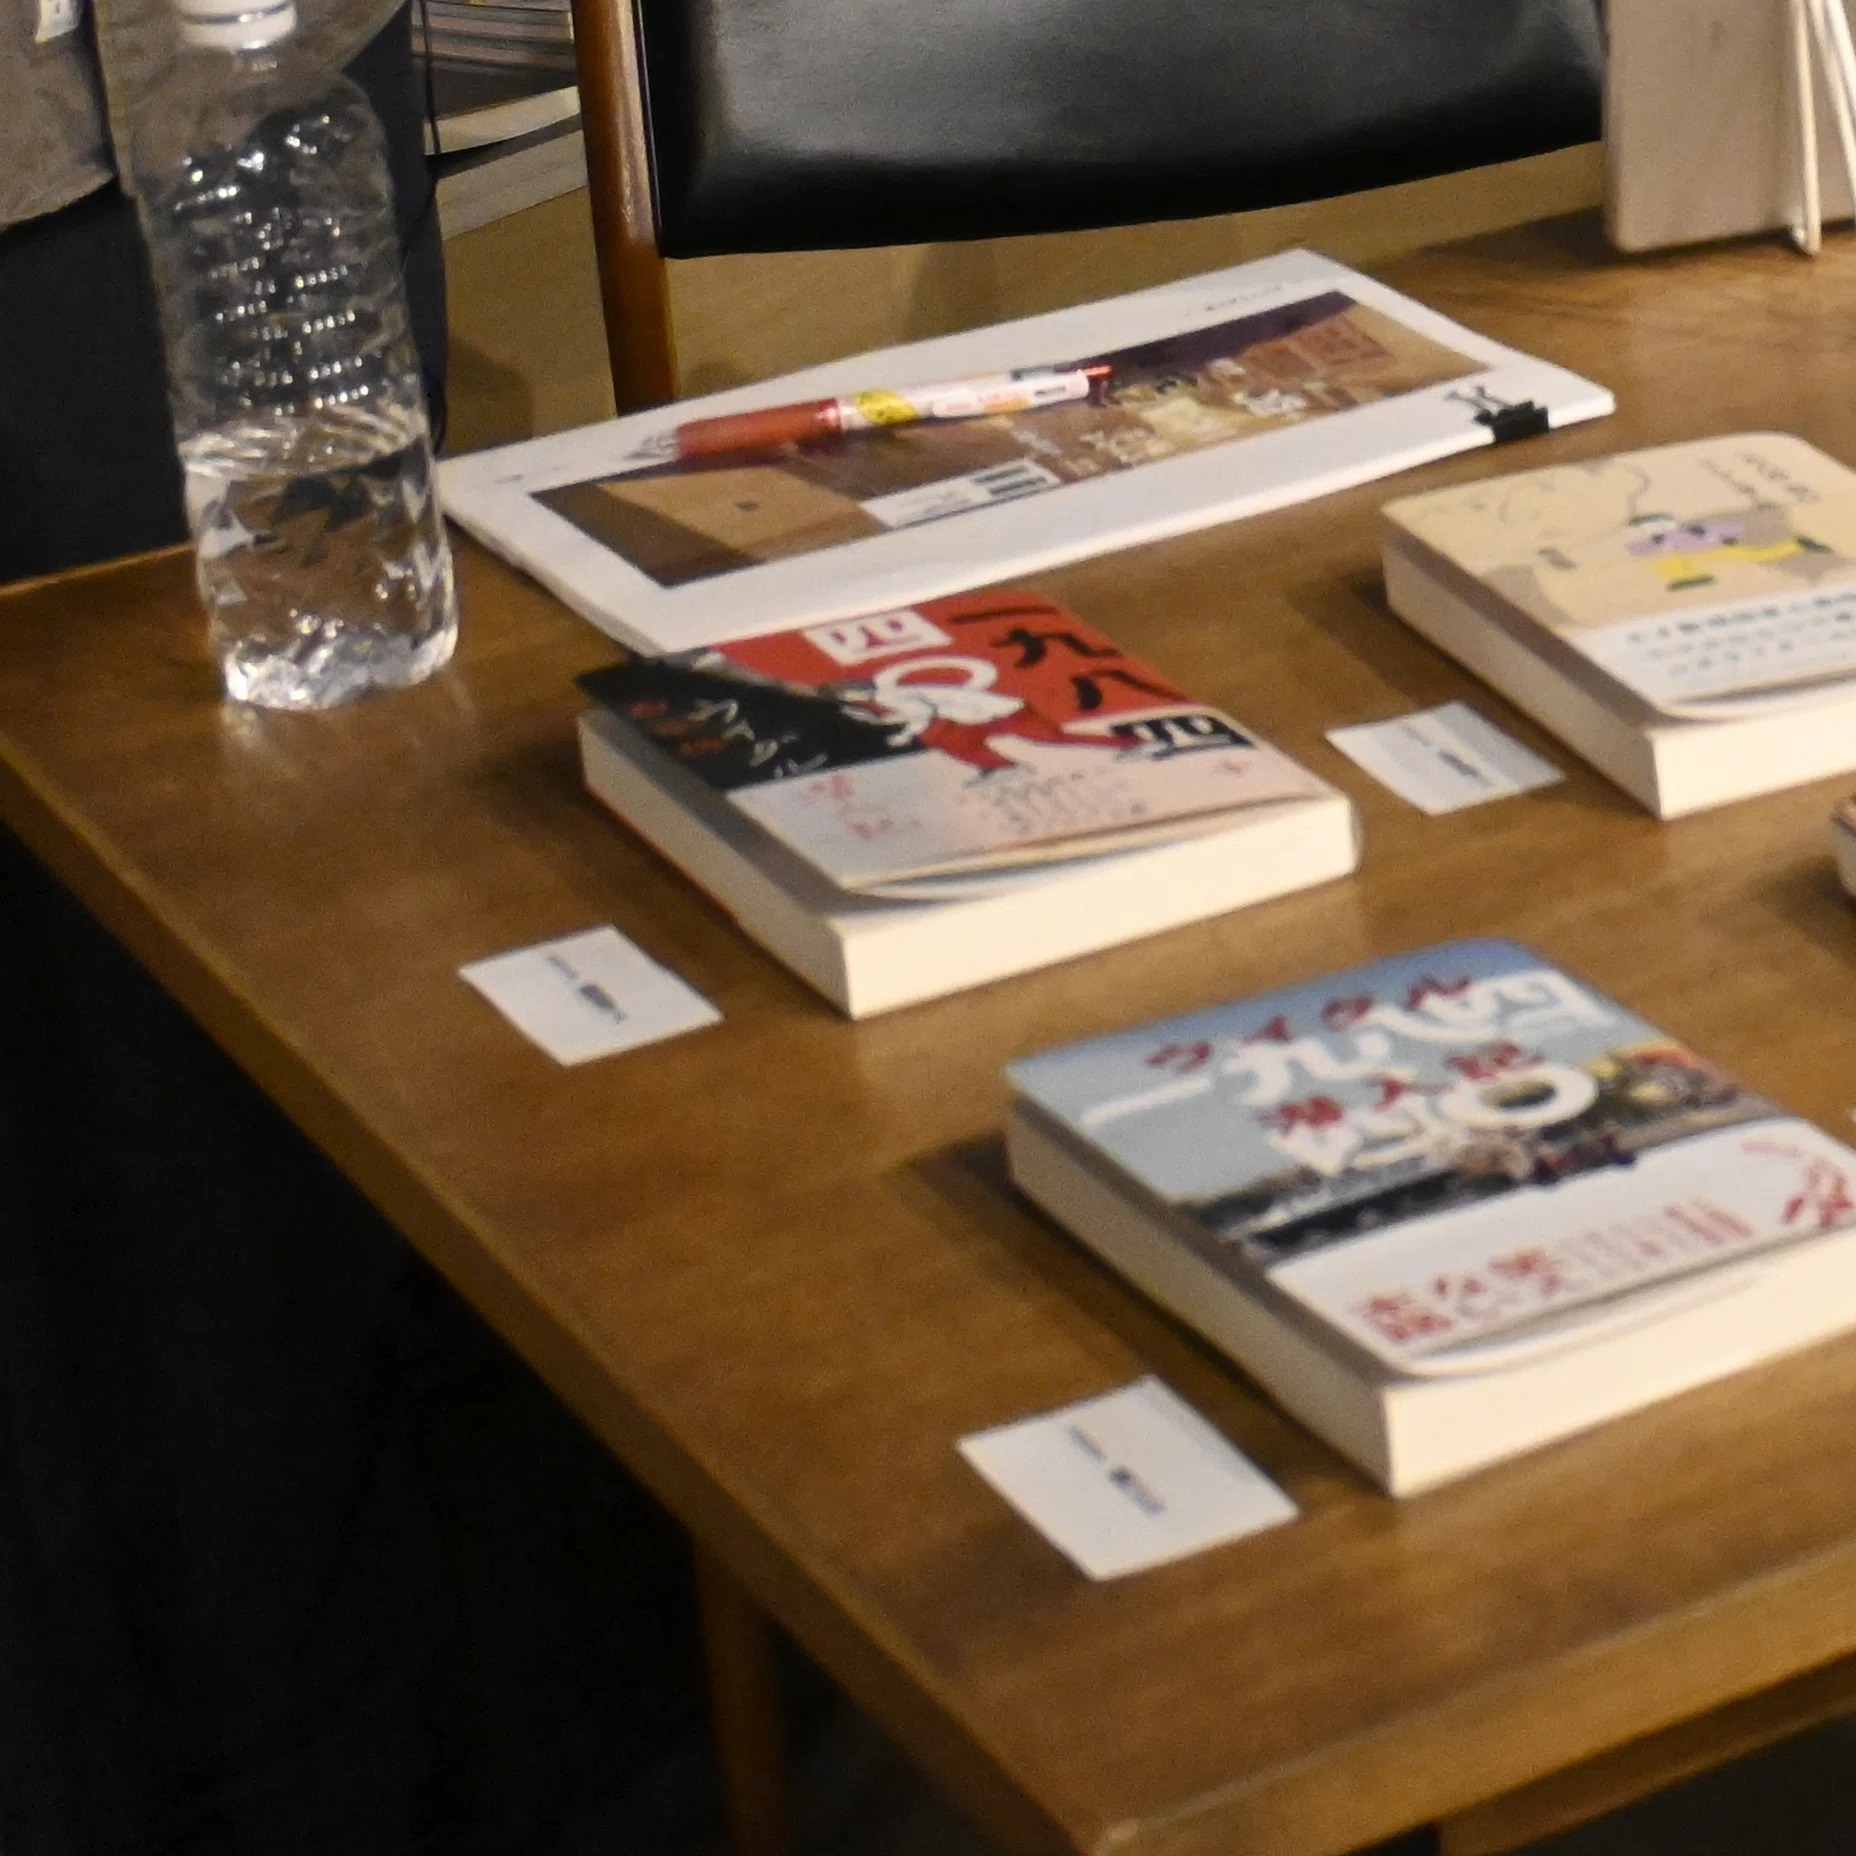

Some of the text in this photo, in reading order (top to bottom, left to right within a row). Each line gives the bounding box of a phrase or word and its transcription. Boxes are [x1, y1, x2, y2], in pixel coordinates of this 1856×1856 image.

[1143, 971, 1477, 1080] ウイグル
[1256, 1037, 1544, 1139] 潜入記
